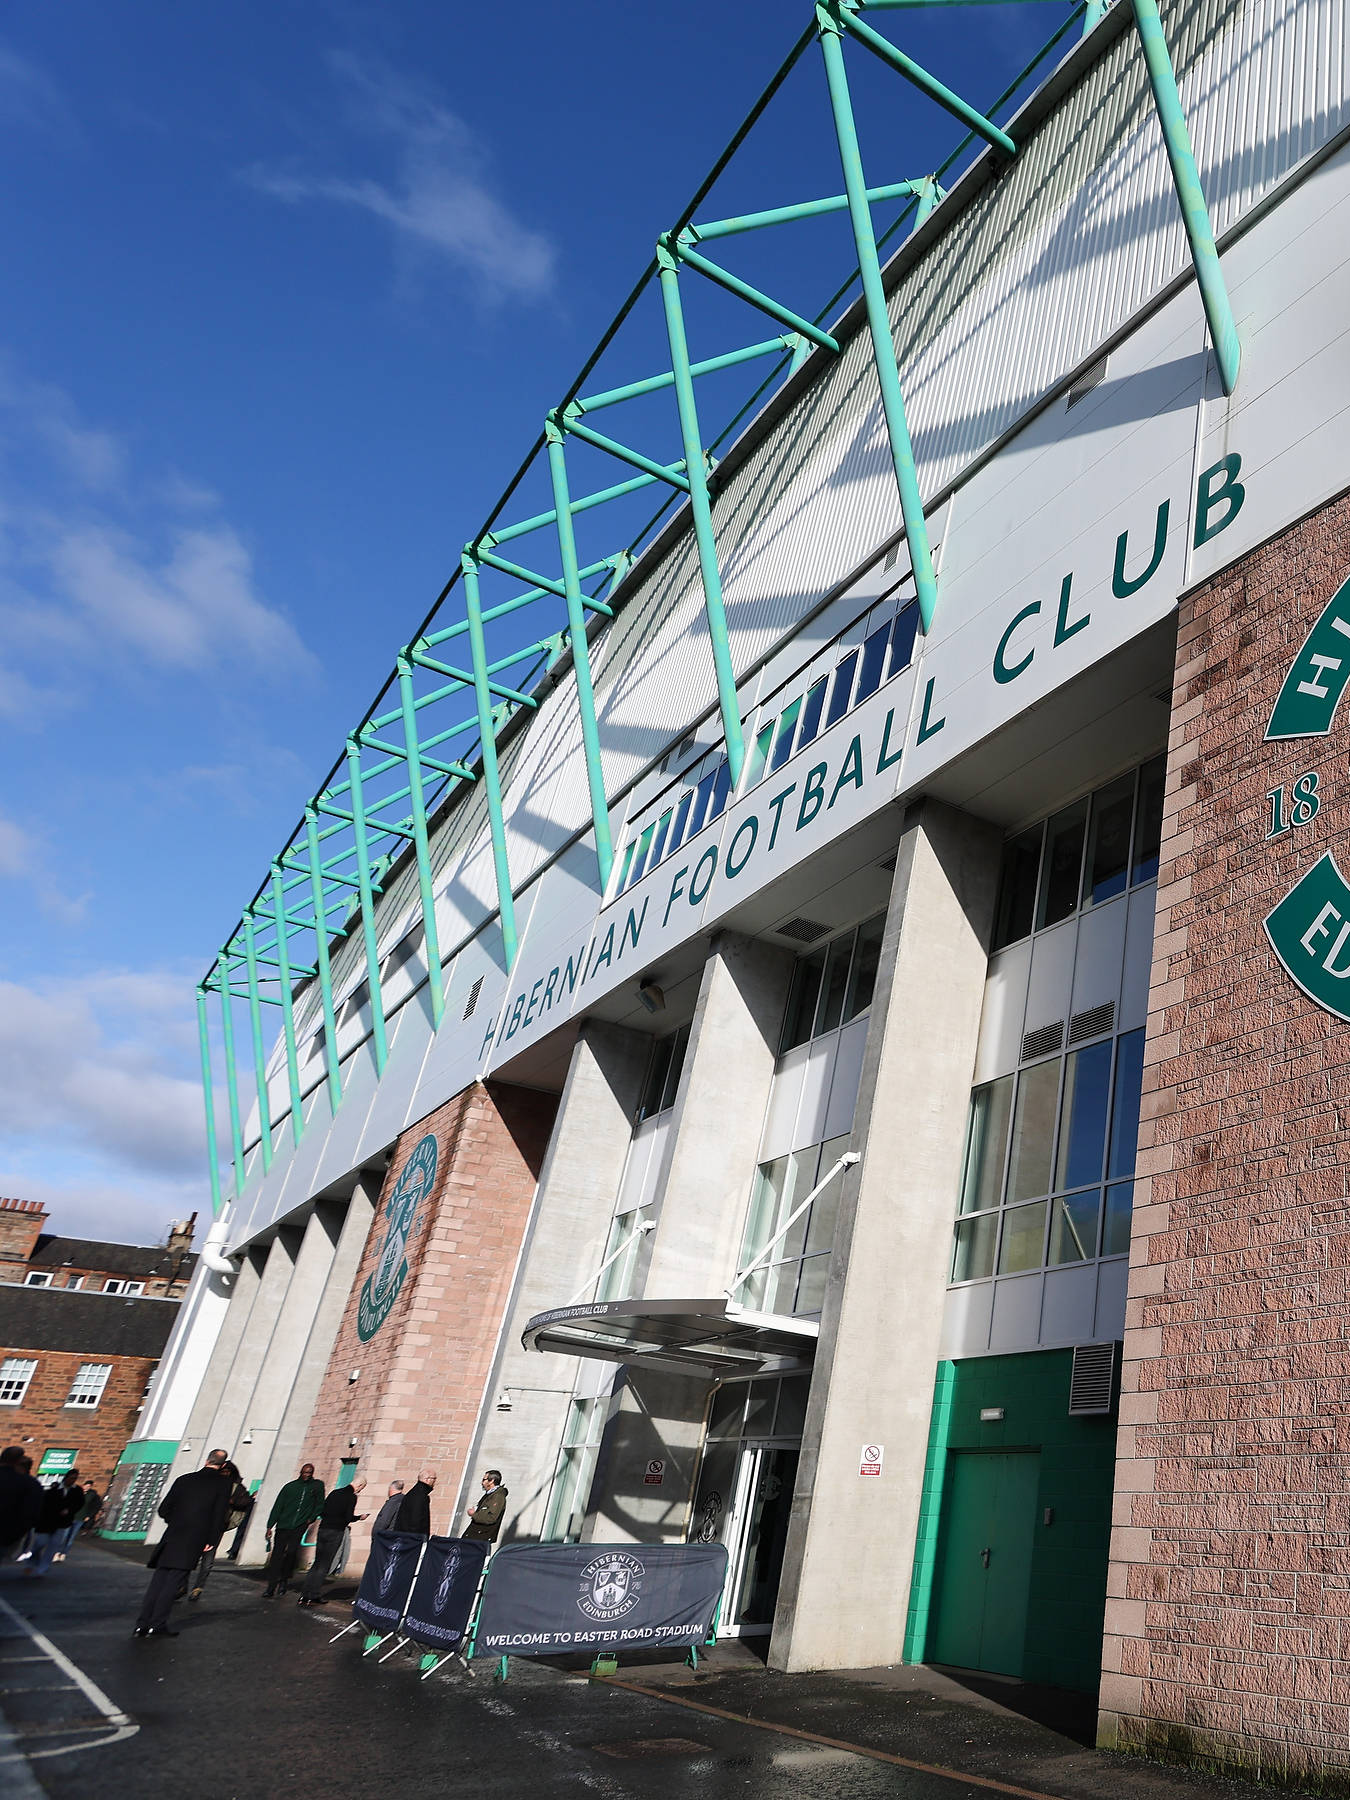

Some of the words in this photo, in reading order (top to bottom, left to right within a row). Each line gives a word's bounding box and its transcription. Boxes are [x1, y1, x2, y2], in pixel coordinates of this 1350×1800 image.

[478, 894, 650, 1061] HIBERNIAN
[662, 679, 946, 928] FOOTBALL
[993, 451, 1245, 686] CLUB
[1265, 772, 1320, 840] 18
[571, 1306, 593, 1317] FOOTBALL
[593, 1305, 609, 1314] CLUB
[587, 1554, 641, 1574] HIBERNIAN
[582, 1599, 633, 1619] EDINBURGH
[485, 1633, 551, 1647] WELCOME
[552, 1632, 571, 1643] TO
[573, 1630, 618, 1643] EASTER
[619, 1628, 653, 1640] ROAD
[654, 1623, 704, 1637] STADIUM
